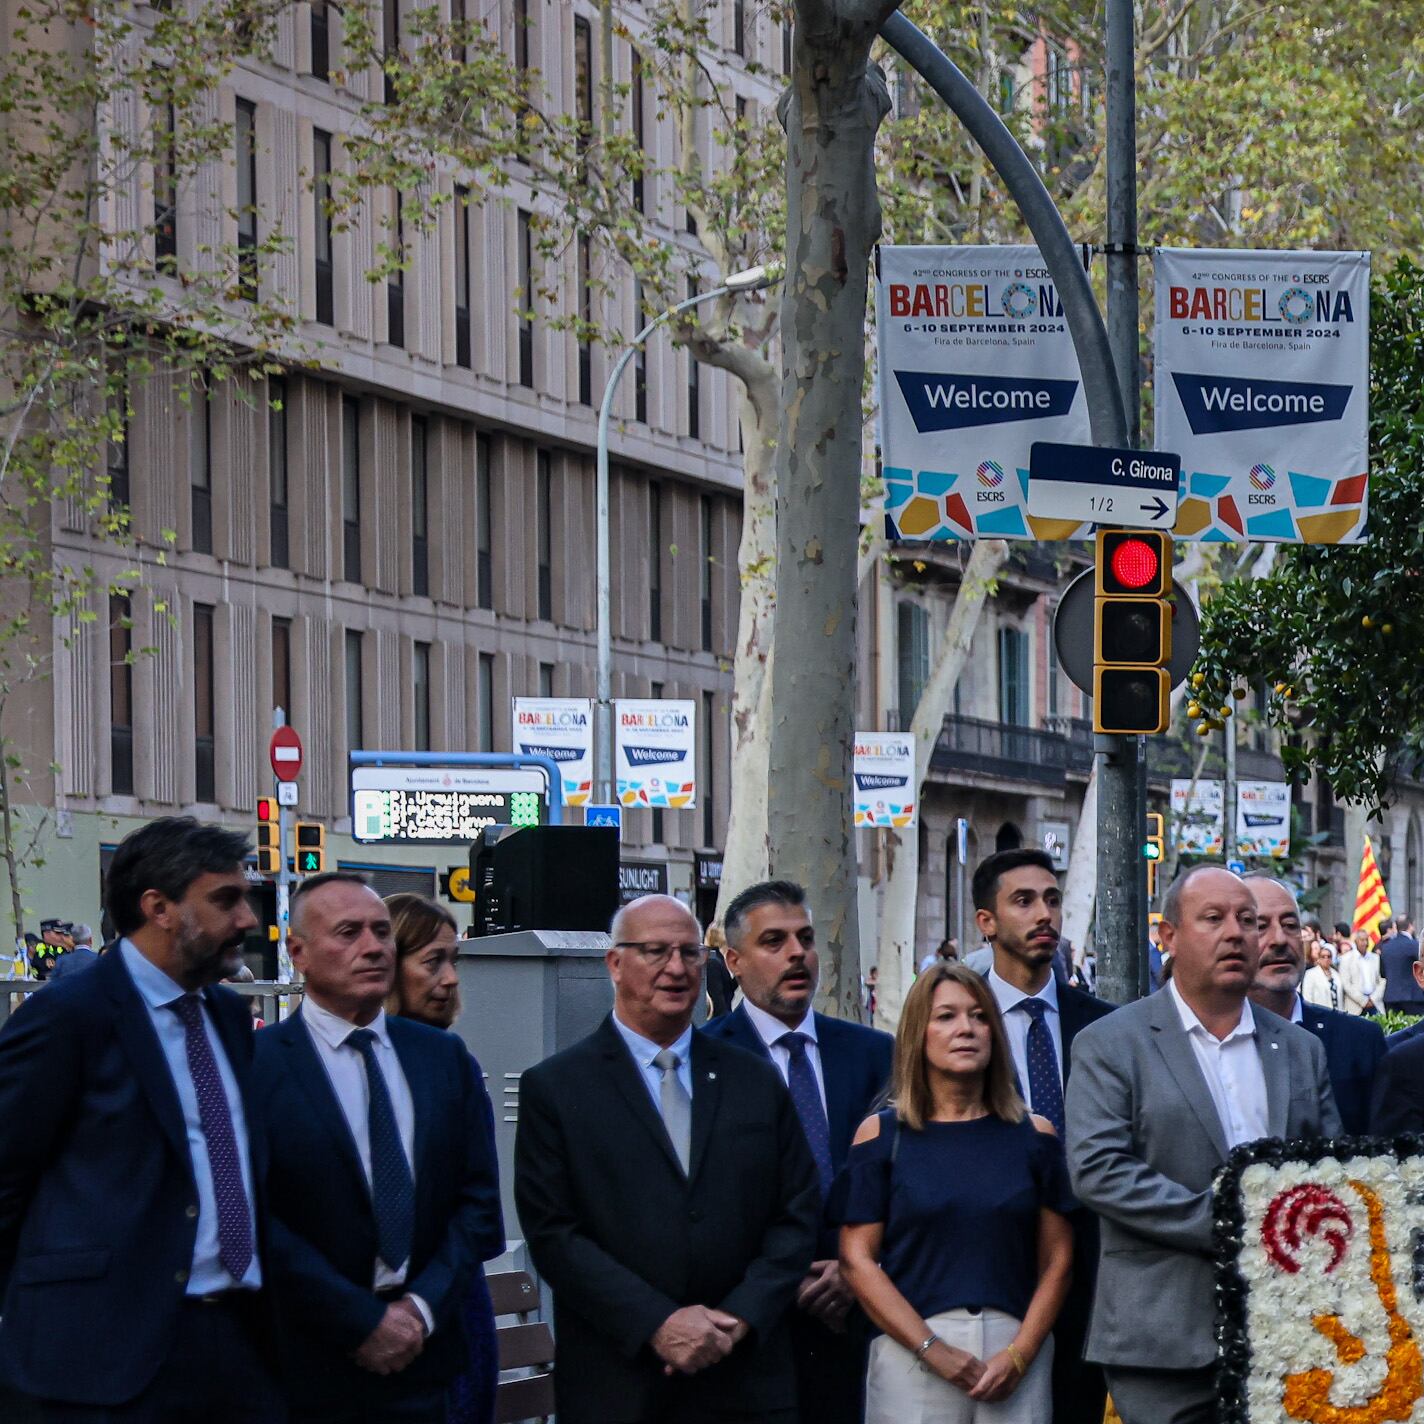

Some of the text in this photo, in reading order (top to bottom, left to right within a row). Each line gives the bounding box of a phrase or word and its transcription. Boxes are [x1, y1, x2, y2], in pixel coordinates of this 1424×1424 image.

[932, 270, 978, 278] CONGRESS
[980, 270, 991, 278] OF
[994, 270, 1010, 278] THE
[1212, 273, 1256, 282] CONGRESS
[1258, 274, 1269, 282] OF
[1273, 274, 1288, 282] THE
[1304, 274, 1330, 284] ESCRS
[1169, 286, 1354, 324] BARCELONA
[940, 324, 1026, 333] SEPTEMBER
[1030, 324, 1065, 333] 2024
[1217, 327, 1302, 338] SEPTEMBER
[1306, 328, 1340, 338] 2024
[934, 337, 1035, 346] Fira de Barcelona, Spain
[1211, 340, 1311, 351] Fira de Barcelona, Spain
[924, 384, 1050, 408] Welcome
[1200, 386, 1325, 413] Welcome
[1111, 458, 1173, 482] C. Girona
[976, 491, 1005, 502] ESCRS
[1248, 494, 1276, 504] ESCRS
[529, 747, 577, 760] Welcome
[631, 748, 679, 761] Welcome
[860, 775, 901, 786] Welcome
[619, 867, 660, 891] SUNLIGHT
